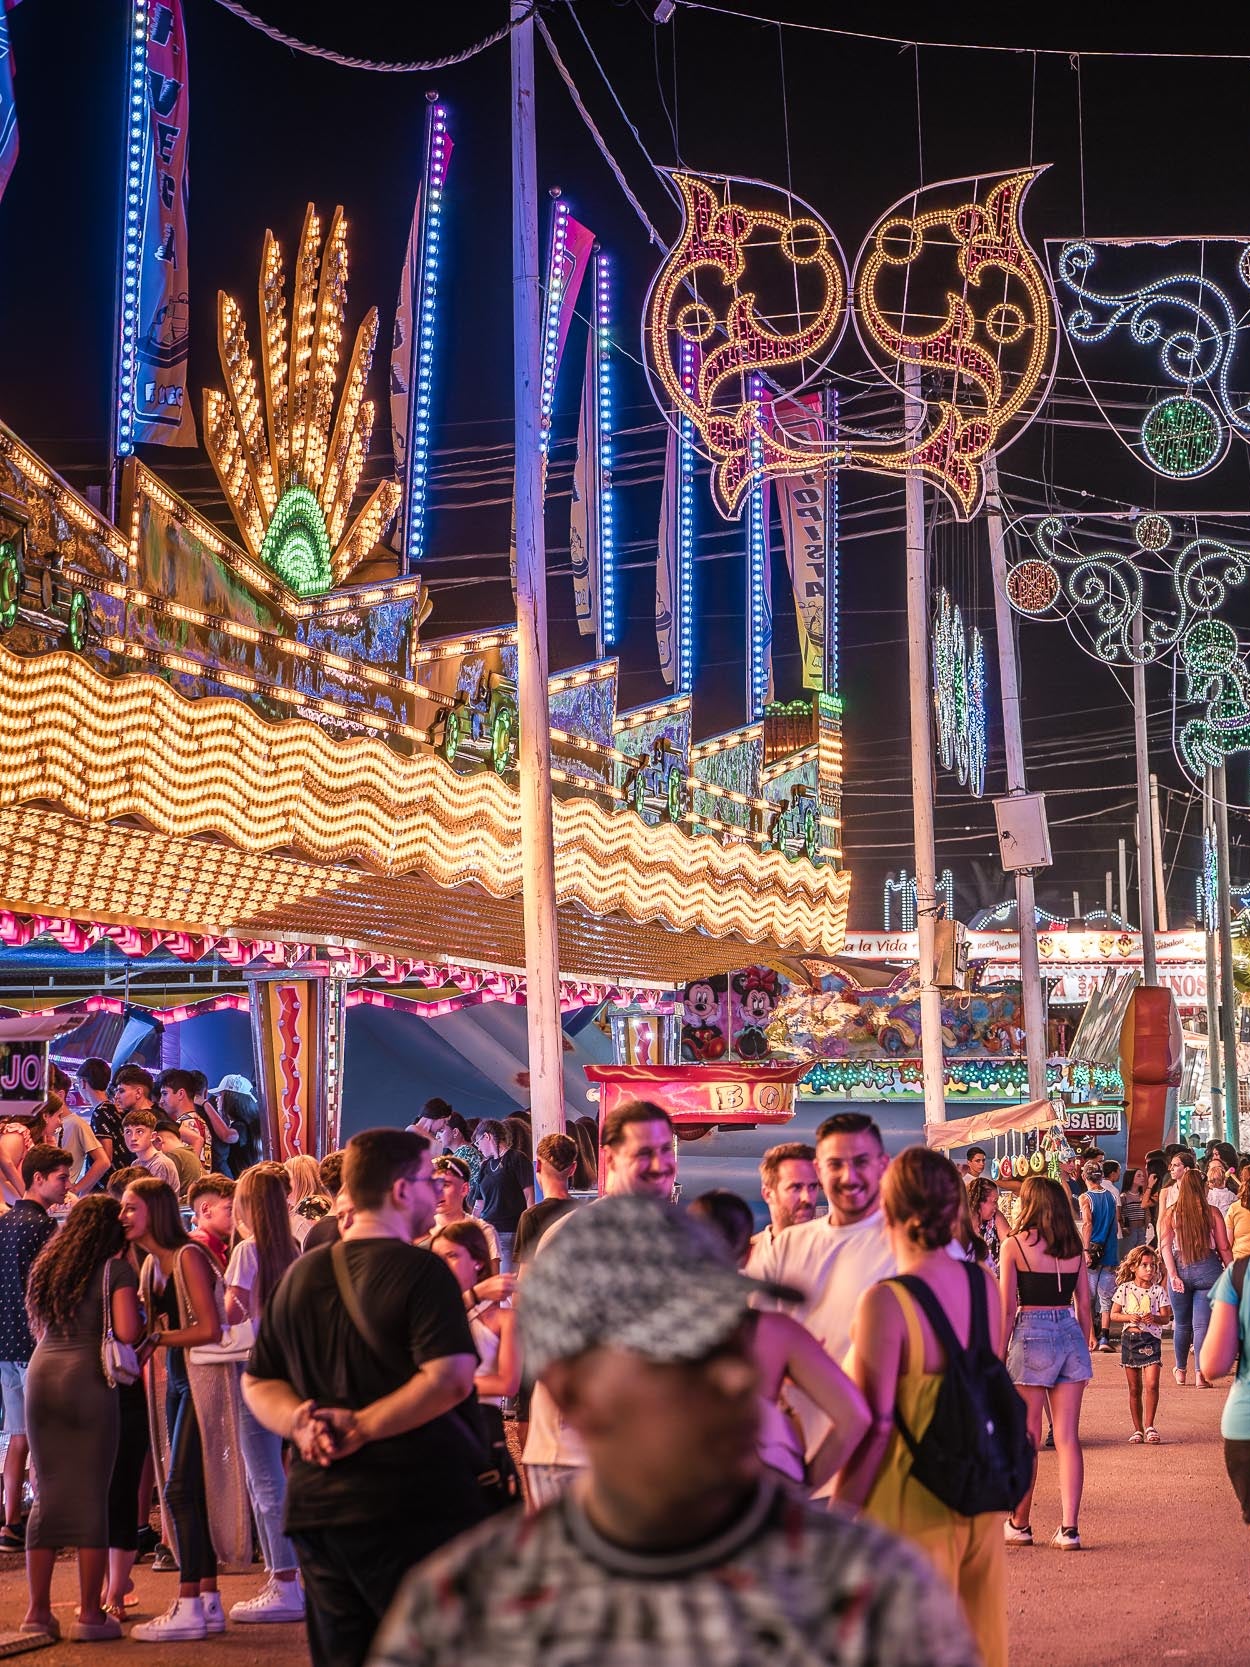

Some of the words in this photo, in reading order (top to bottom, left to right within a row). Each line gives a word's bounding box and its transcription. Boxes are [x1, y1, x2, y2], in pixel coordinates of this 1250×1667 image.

[859, 939, 871, 951] la
[877, 939, 907, 951] Vida
[1078, 975, 1087, 997] LOS
